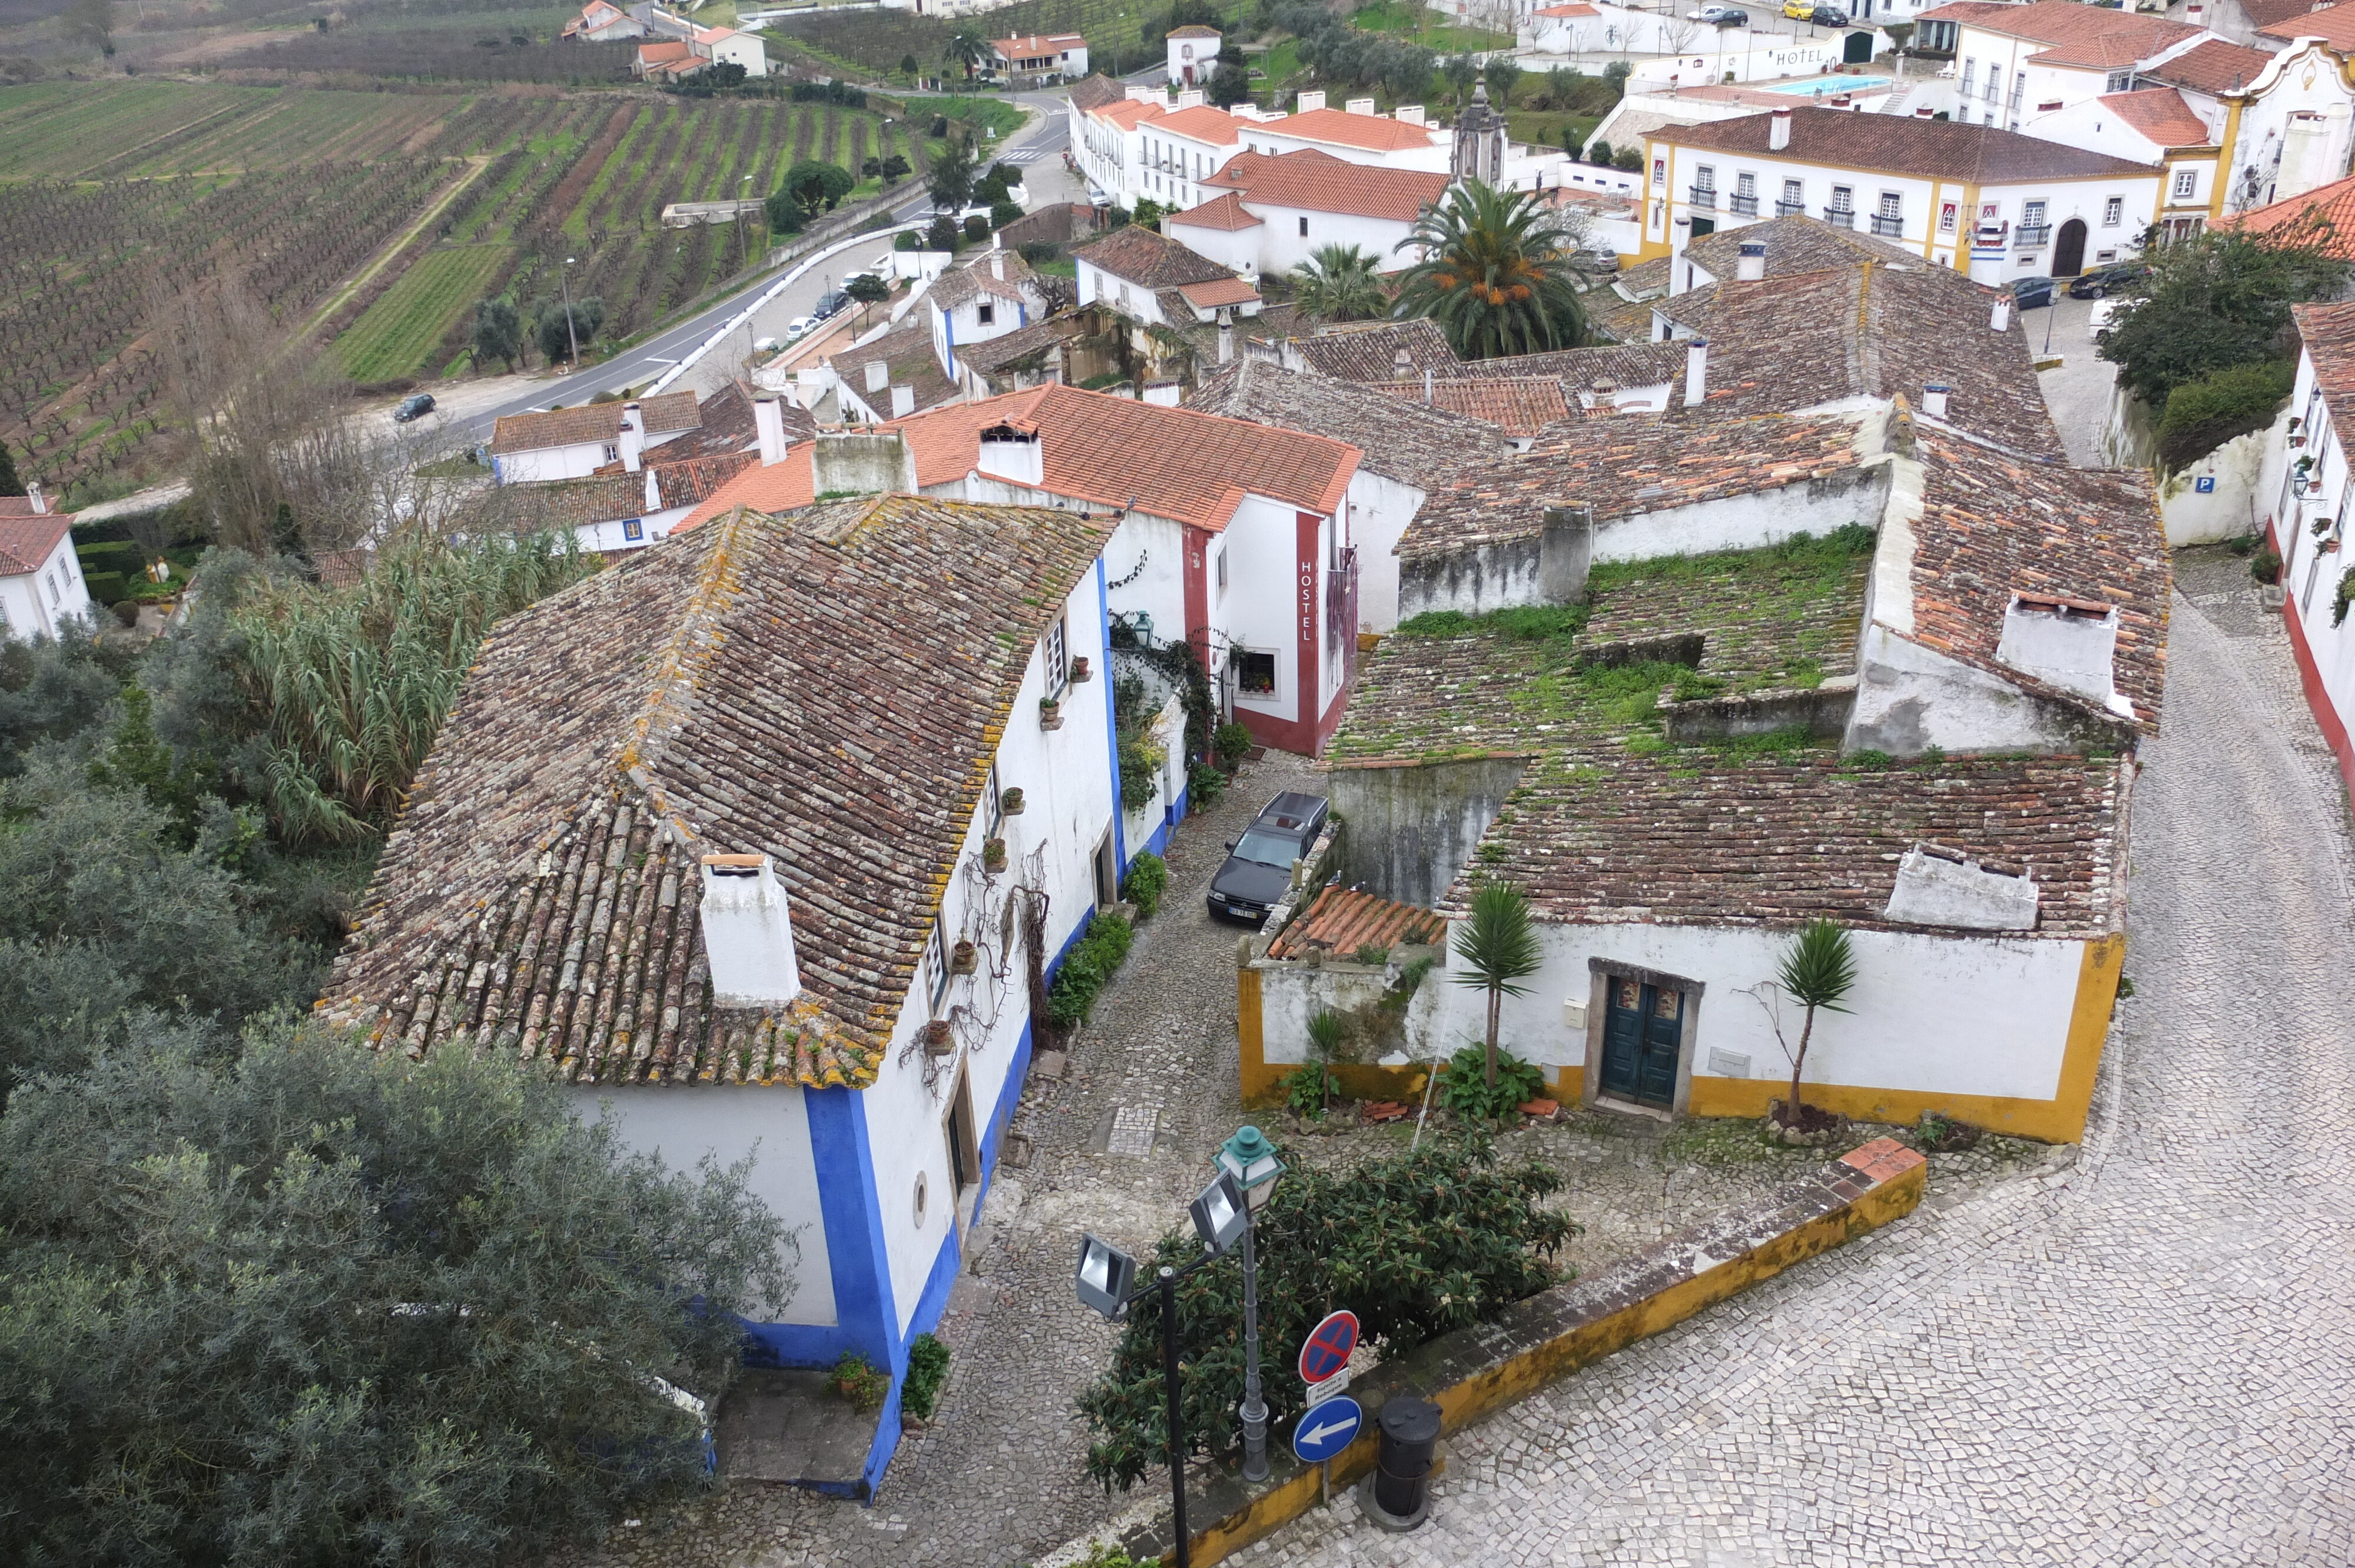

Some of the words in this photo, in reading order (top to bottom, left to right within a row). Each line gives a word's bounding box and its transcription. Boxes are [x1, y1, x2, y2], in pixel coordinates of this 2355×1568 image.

[1776, 48, 1822, 65] HOTEL
[2199, 479, 2210, 489] P
[1301, 562, 1311, 640] HOSTEL
